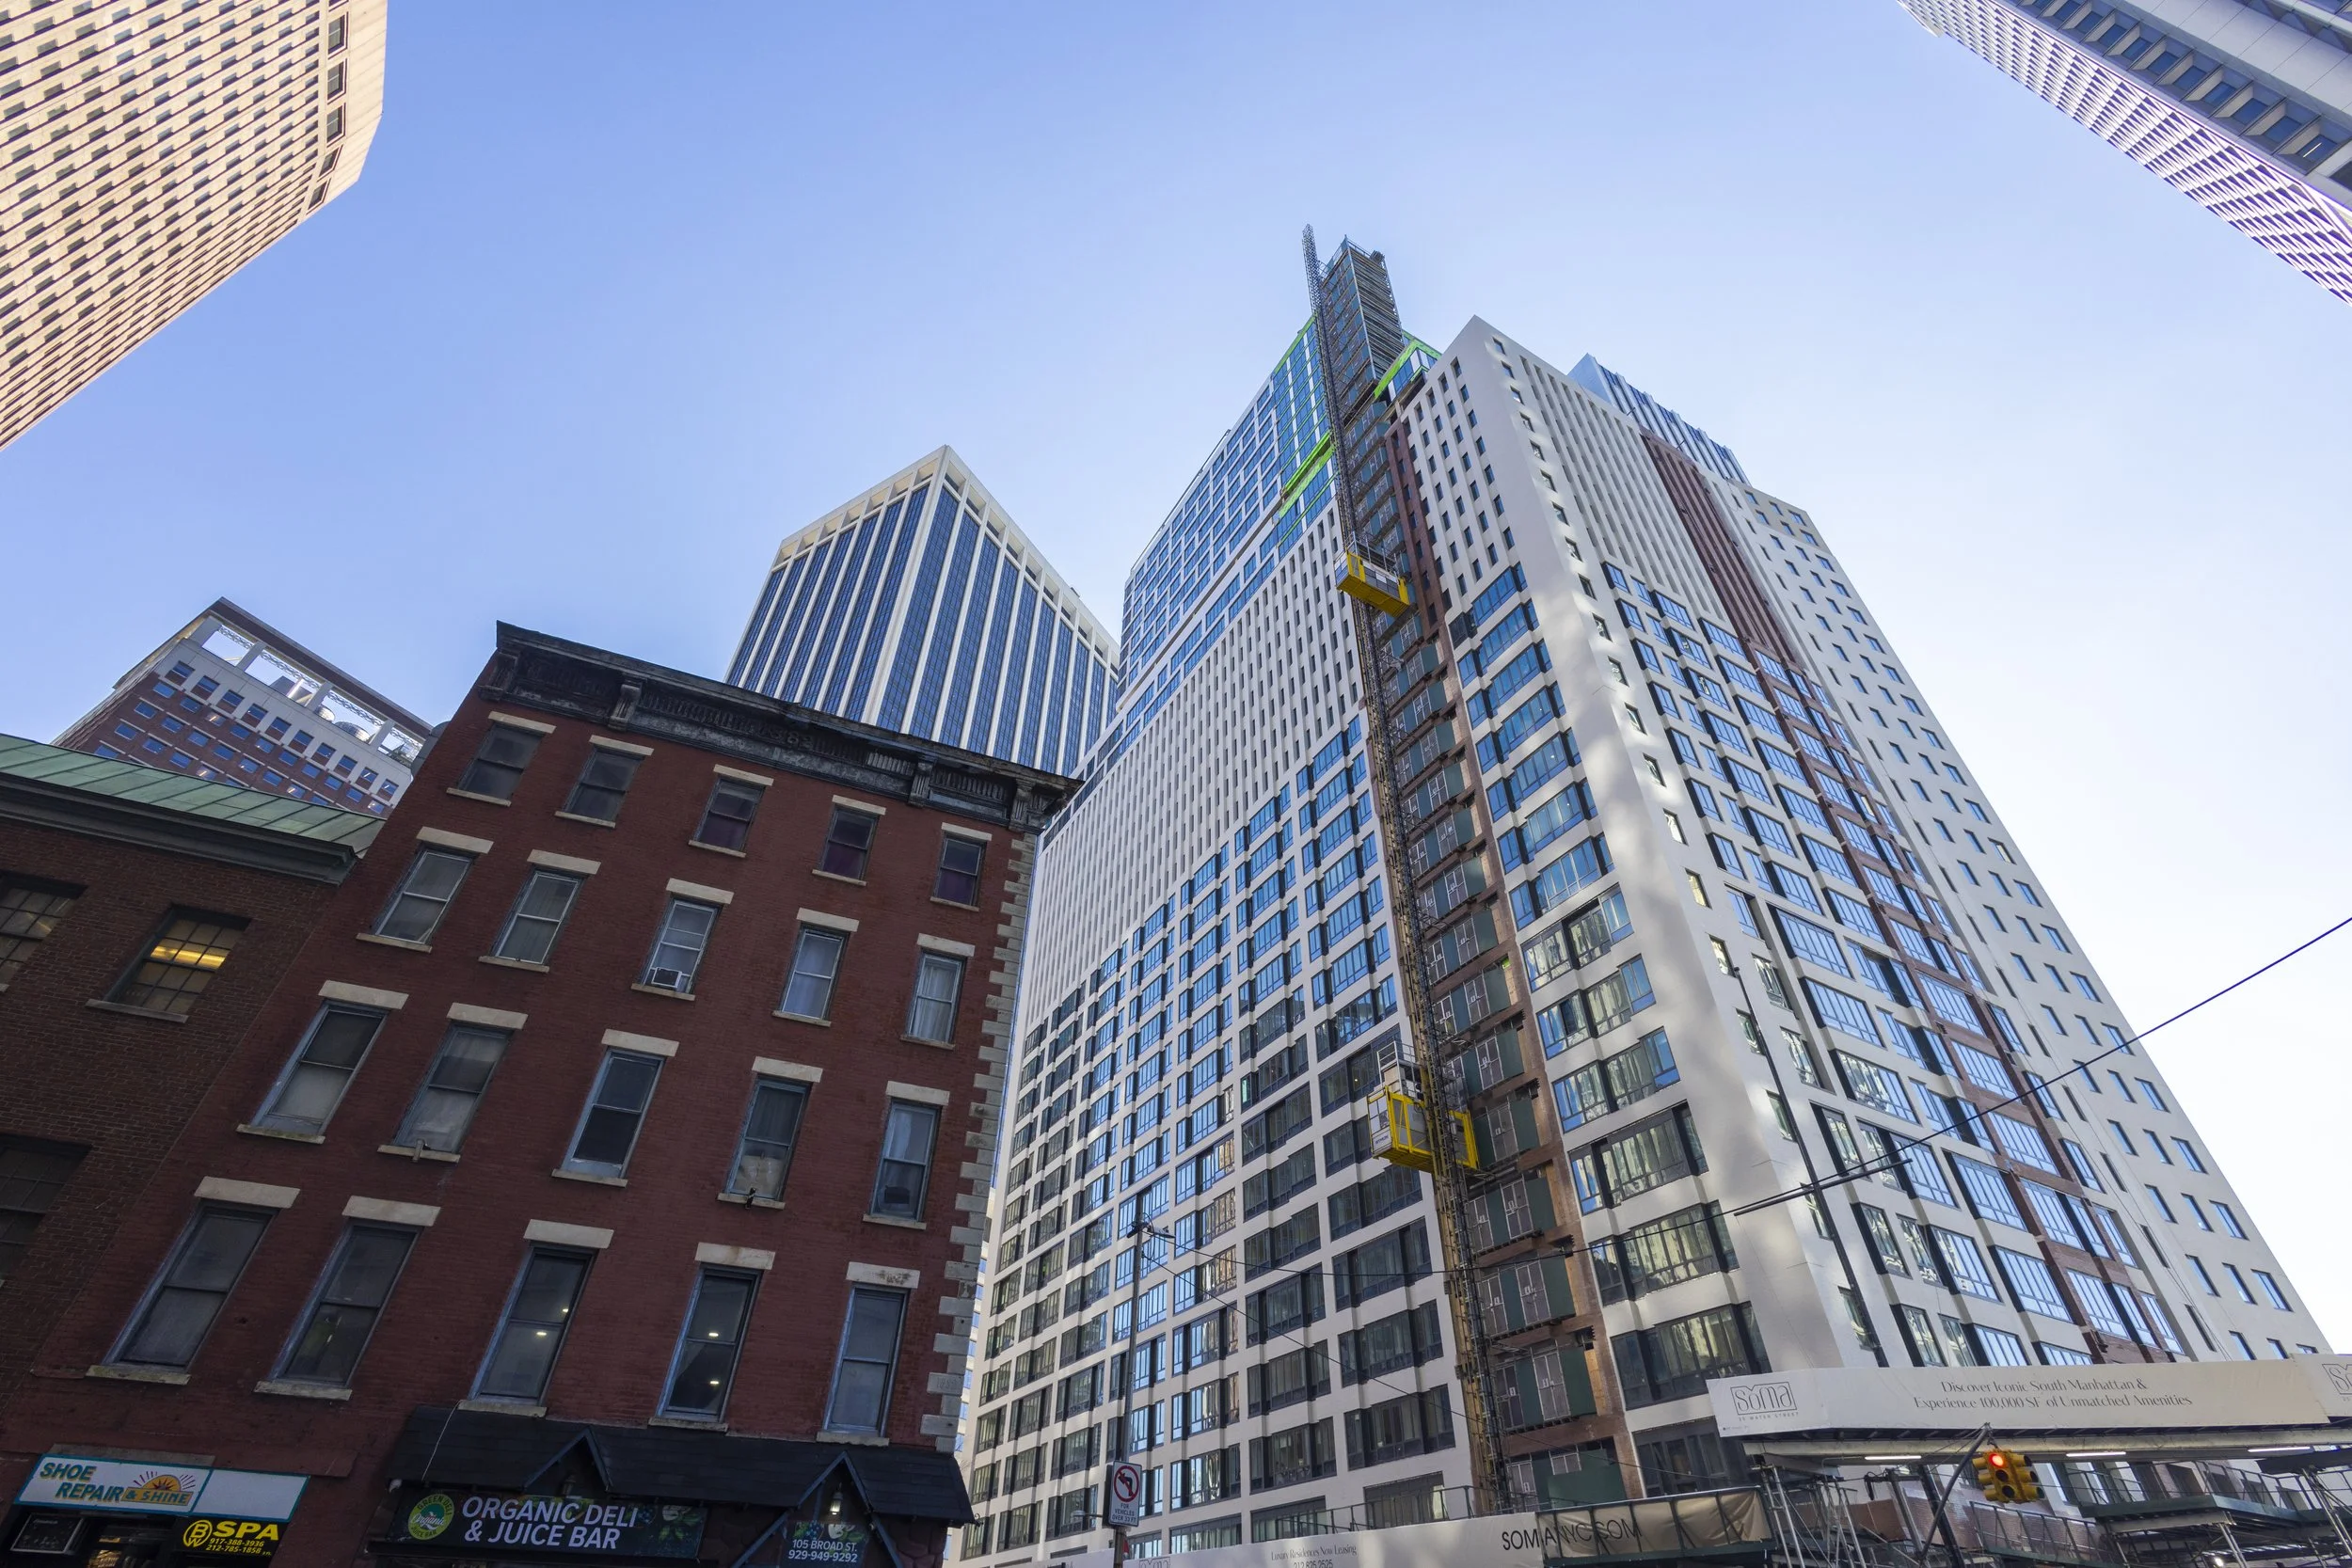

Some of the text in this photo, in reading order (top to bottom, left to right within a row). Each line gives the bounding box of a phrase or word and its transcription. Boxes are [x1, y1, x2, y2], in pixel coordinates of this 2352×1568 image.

[1941, 1378, 2148, 1392] Discover Iconic South Manhattan &
[1914, 1394, 2193, 1410] Experience 100,000 SF of Unmatched Amenities
[40, 1462, 97, 1482] SHOE
[55, 1482, 189, 1504] REPAIR & SHINE
[462, 1496, 638, 1528] ORGANIC DELI
[213, 1520, 278, 1541] SPA
[464, 1520, 621, 1549] & JUICE BAR
[1502, 1518, 1642, 1550] SOMANYCCOM
[787, 1549, 858, 1562] 929-949-9292
[792, 1539, 857, 1552] 105 BROAD ST.
[1271, 1544, 1357, 1560] Luxury Residences Now Leasing
